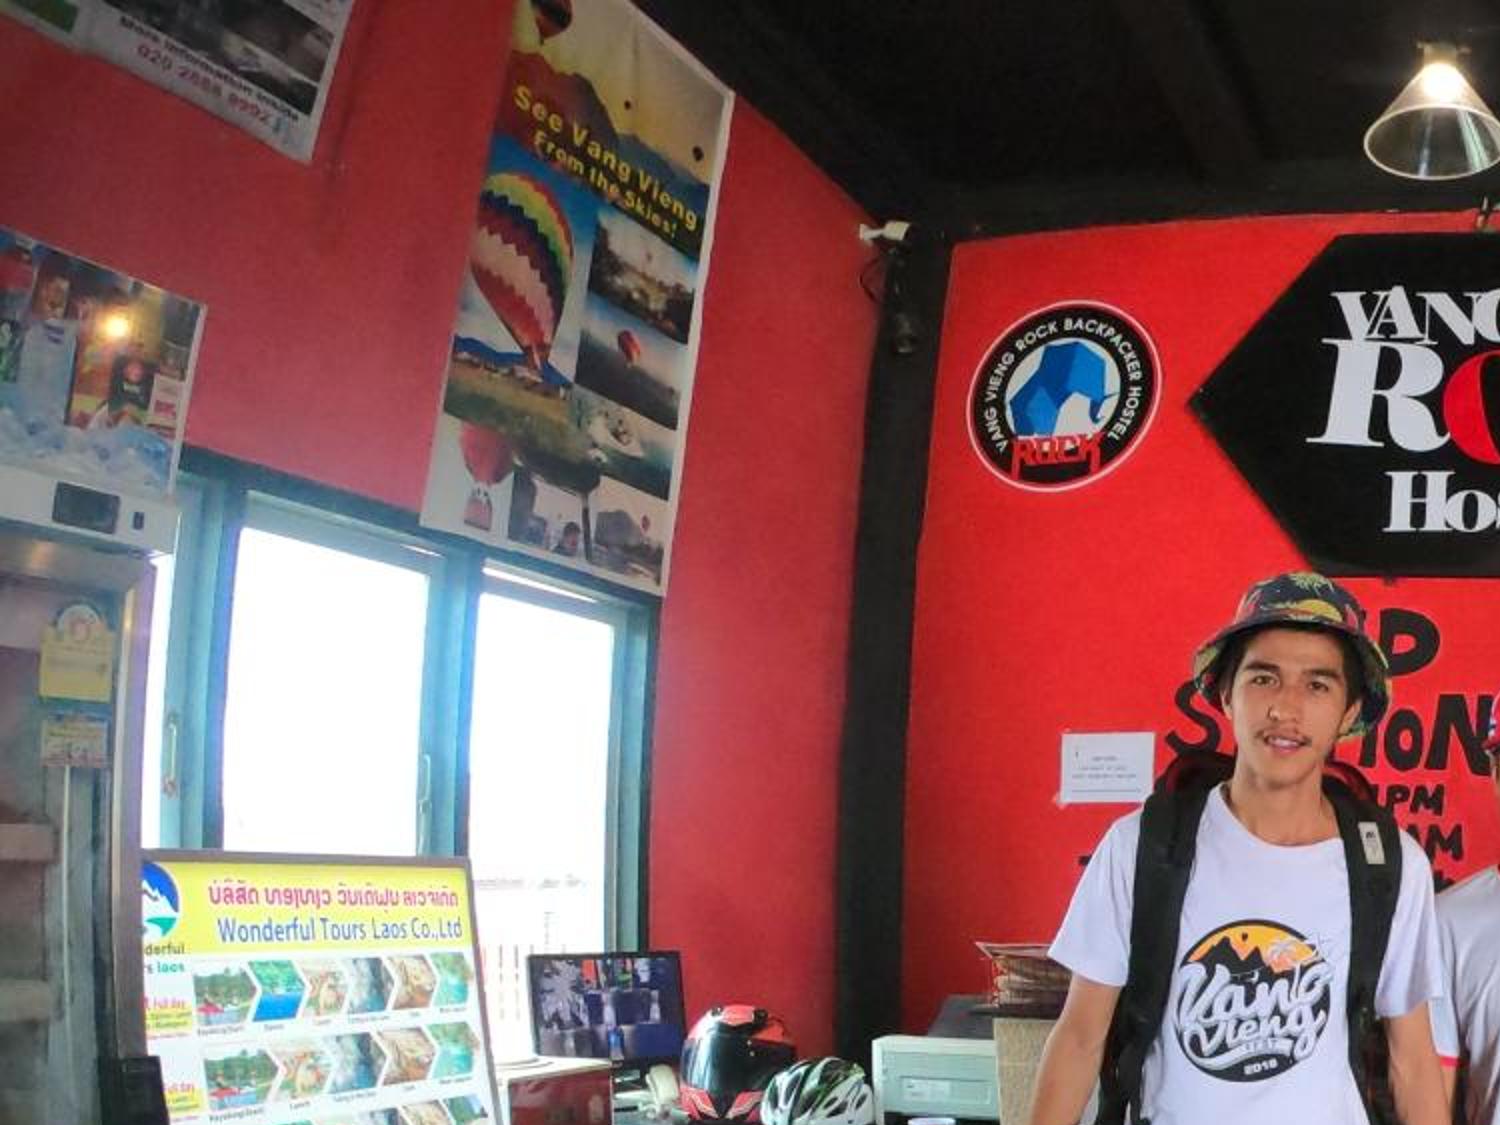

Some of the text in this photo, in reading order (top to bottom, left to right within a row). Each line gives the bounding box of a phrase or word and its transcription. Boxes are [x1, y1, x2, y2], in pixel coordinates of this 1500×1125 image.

[514, 84, 698, 232] See Vang Vieng
[533, 129, 585, 176] From
[983, 316, 1144, 454] VANG VIENG ROCK BACKPACKER HOSTEL
[1010, 432, 1106, 481] ROCK
[217, 917, 317, 943] Wonderful
[319, 917, 368, 940] Tours
[372, 916, 407, 938] Laos
[1177, 960, 1334, 1030] Vang
